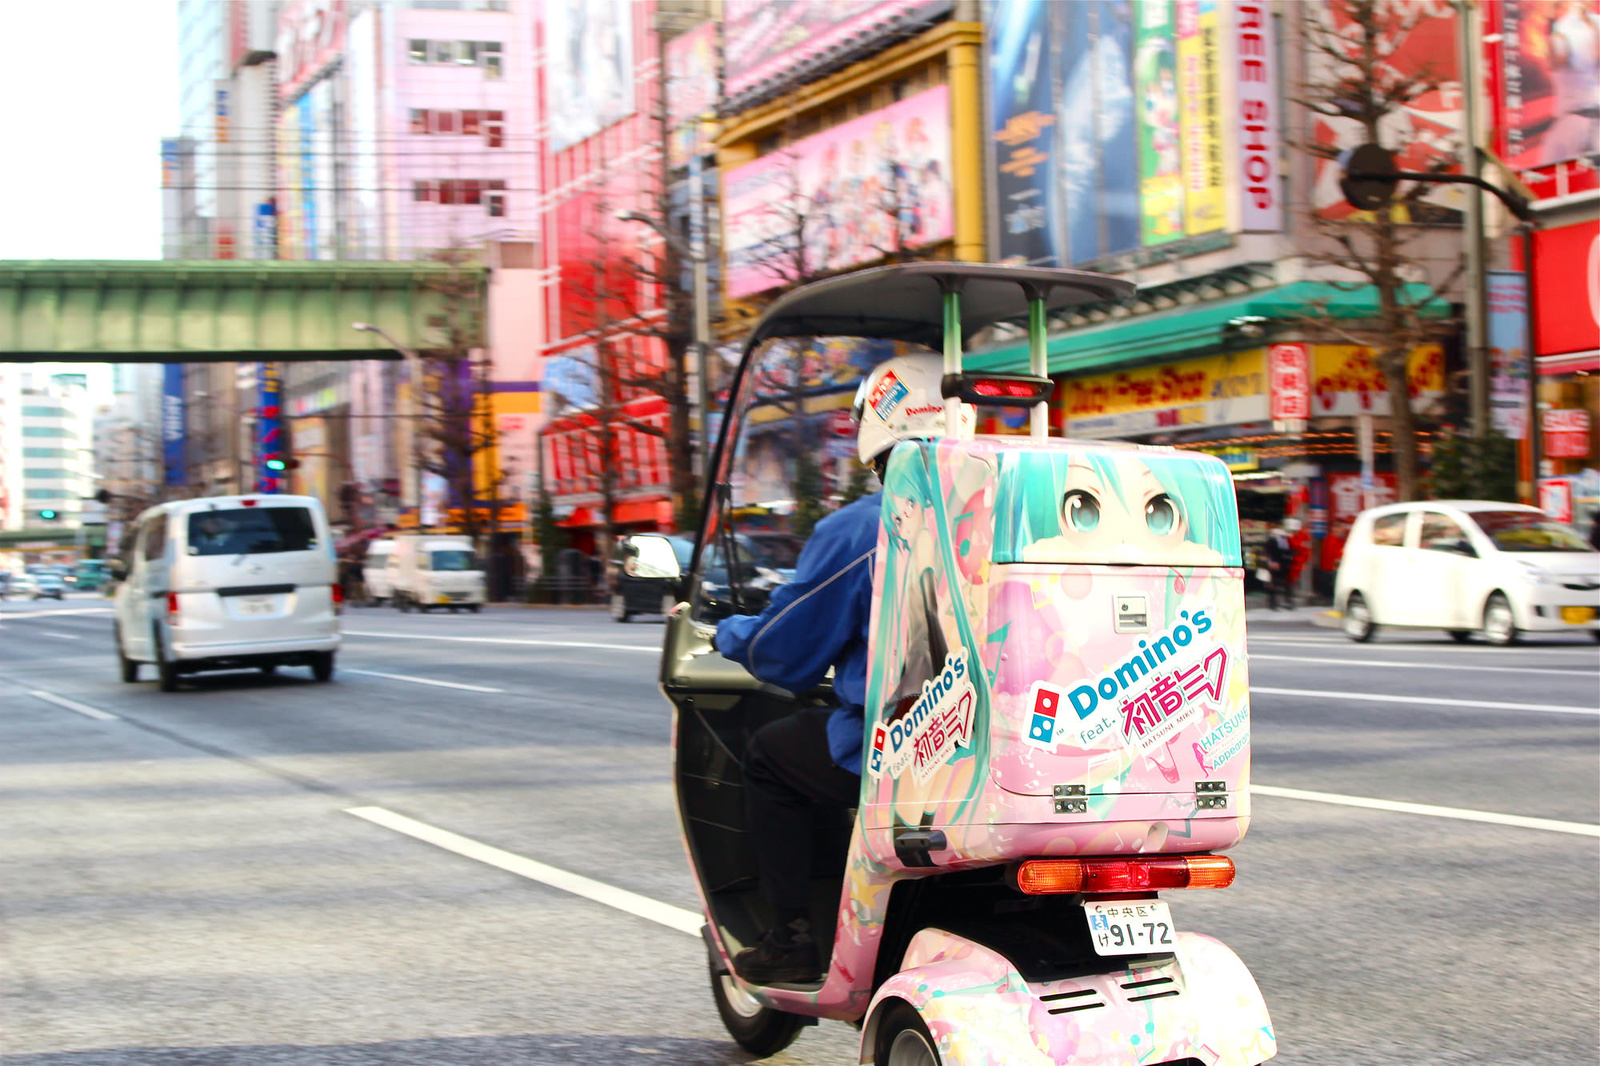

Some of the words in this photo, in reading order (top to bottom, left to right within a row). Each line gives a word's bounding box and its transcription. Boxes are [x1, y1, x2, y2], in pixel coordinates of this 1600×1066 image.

[1237, 0, 1267, 83] REE
[1242, 99, 1272, 210] SHOP
[1068, 610, 1212, 720] Domino's
[890, 657, 965, 753] Domino's
[1142, 724, 1174, 749] HATSUNE
[1176, 707, 1196, 723] MIKU
[1201, 704, 1249, 750] HATSUNE
[1080, 718, 1116, 745] feat.
[1107, 907, 1149, 918] 中央区
[1110, 922, 1172, 947] 91-72
